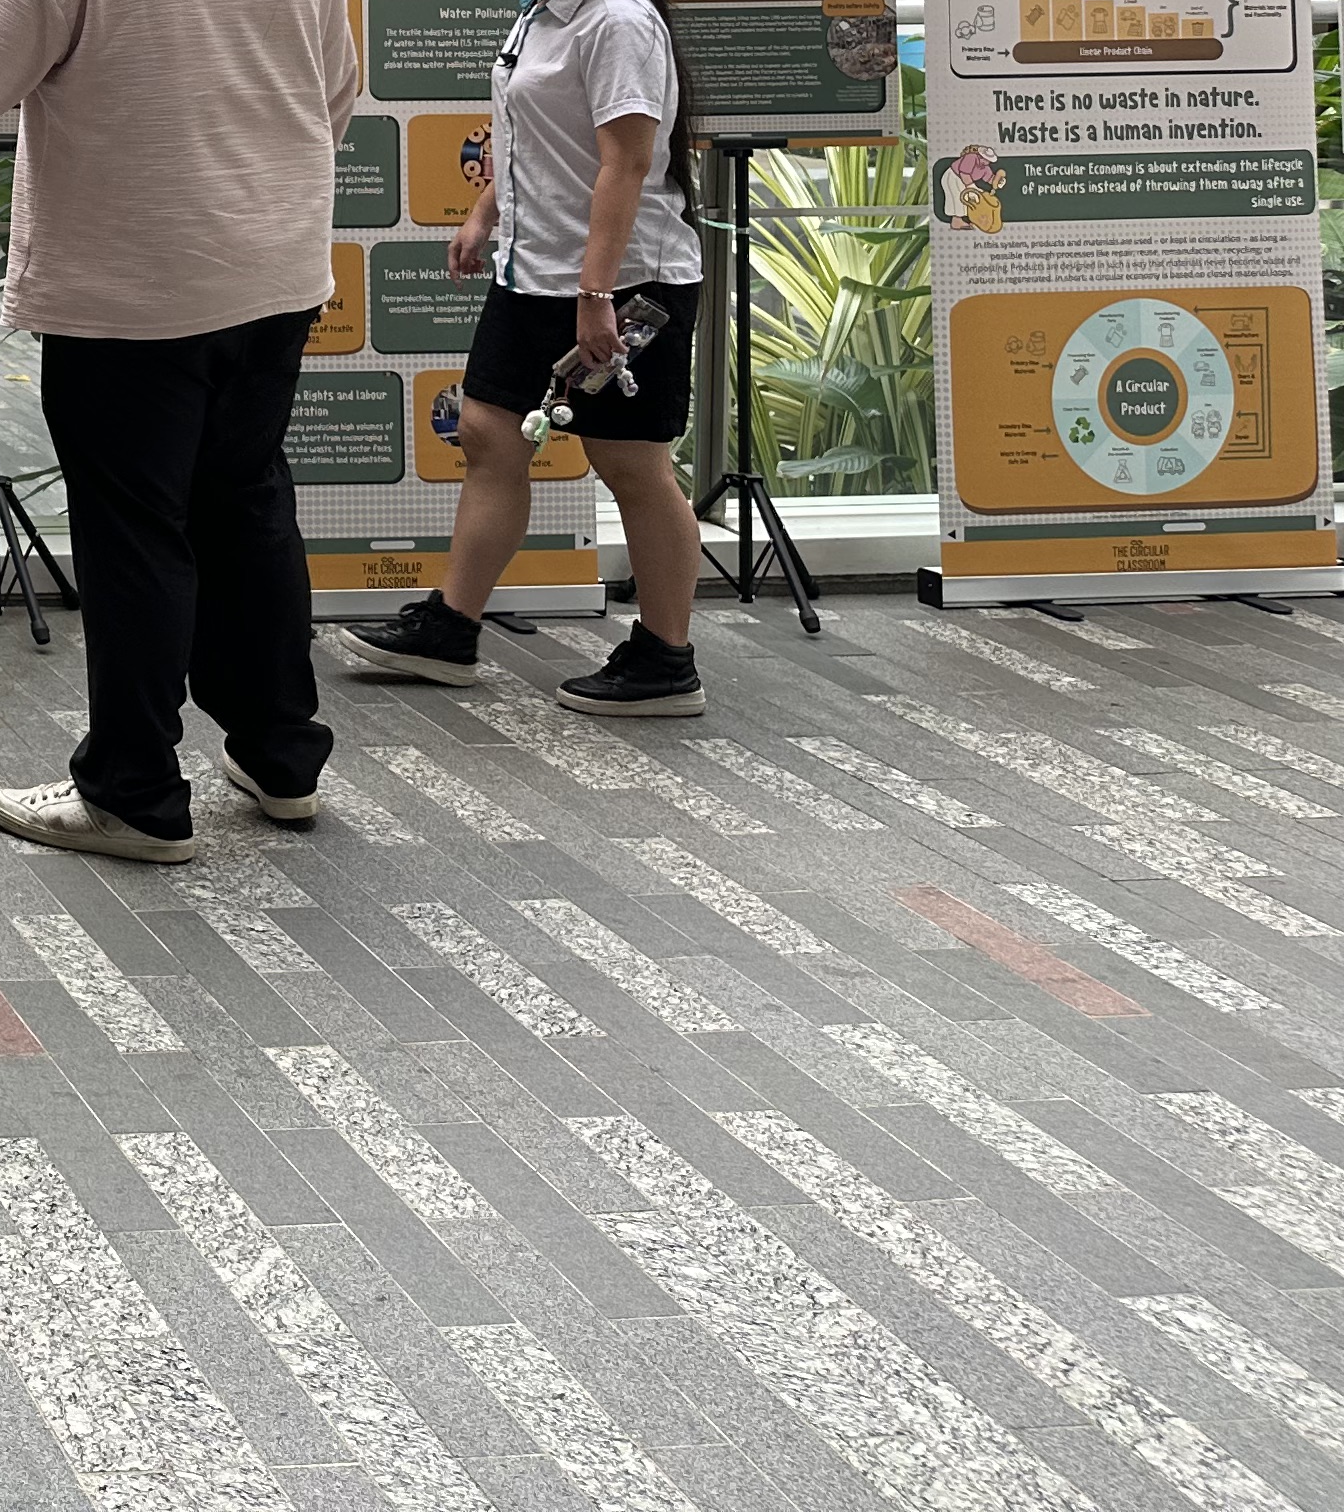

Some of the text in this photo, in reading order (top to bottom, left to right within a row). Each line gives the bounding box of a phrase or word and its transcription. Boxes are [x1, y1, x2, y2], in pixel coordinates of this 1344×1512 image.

[440, 8, 516, 18] Water Pollution
[993, 87, 1259, 112] There is no waste in nature.
[998, 118, 1262, 143] Waste is a human invention.
[1115, 379, 1169, 393] A Circular
[1121, 402, 1165, 415] Product
